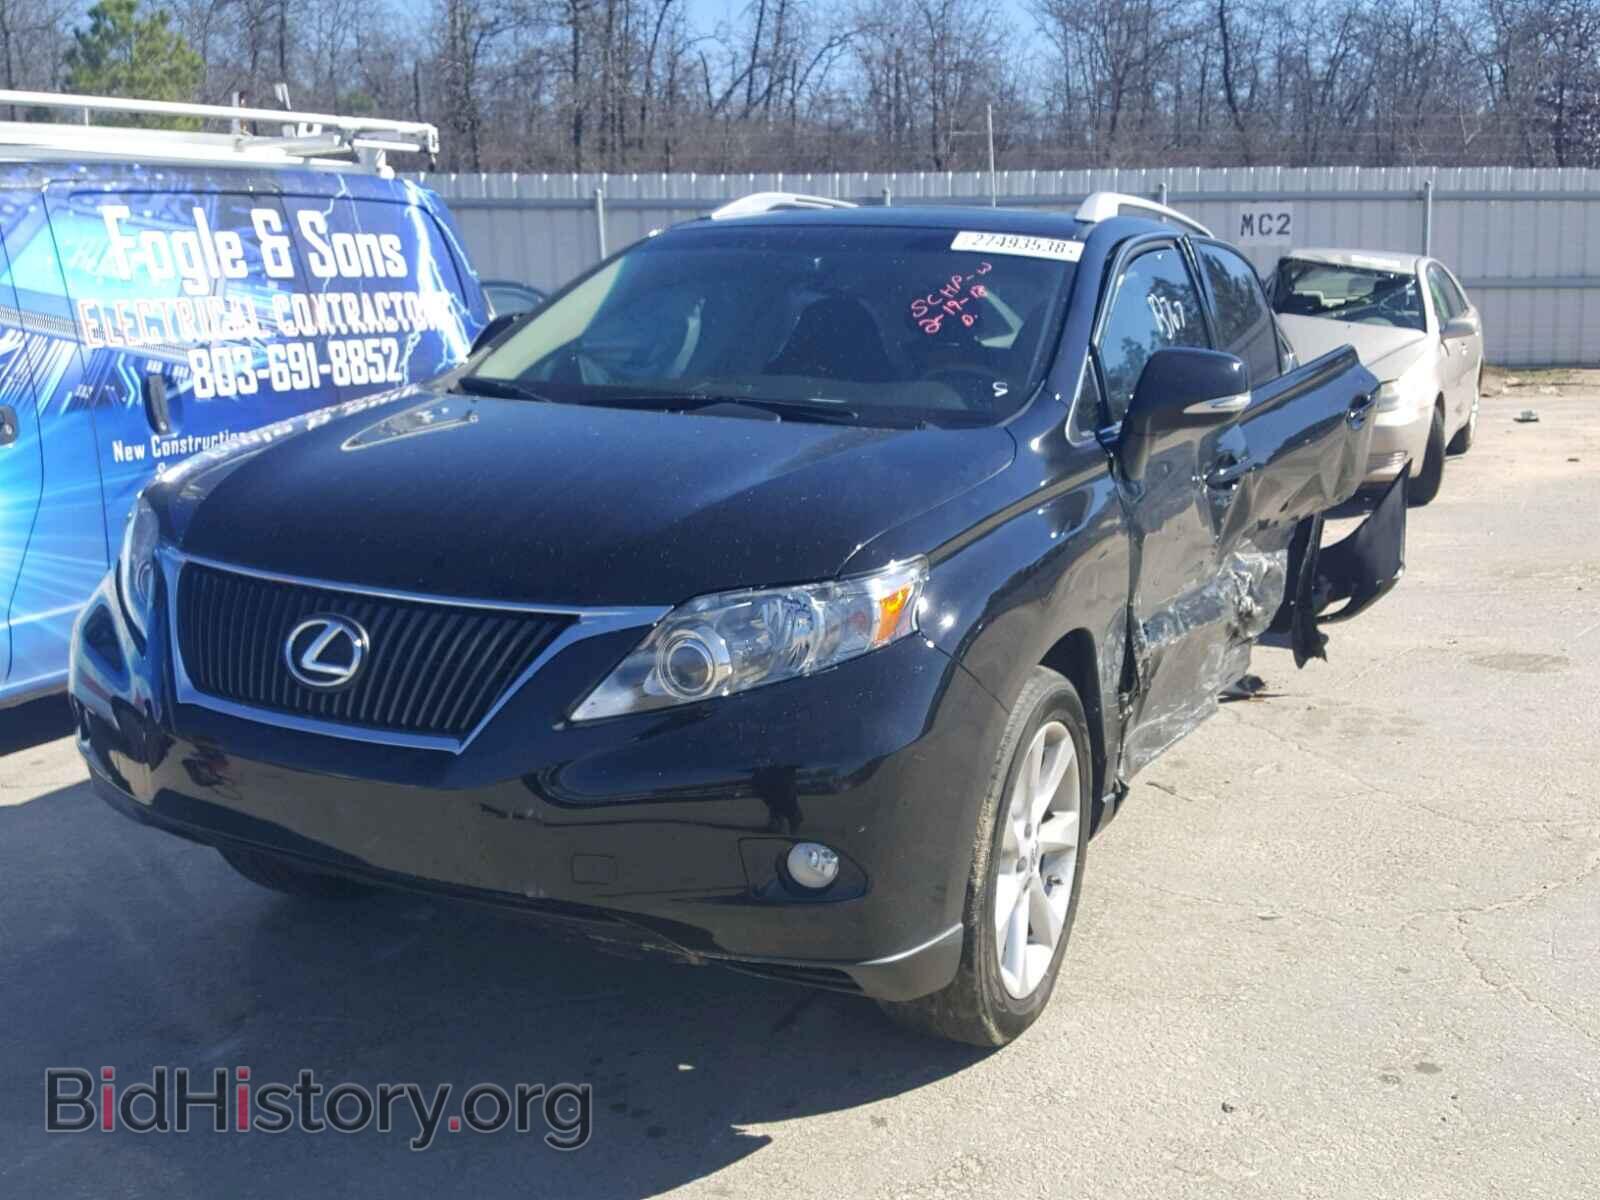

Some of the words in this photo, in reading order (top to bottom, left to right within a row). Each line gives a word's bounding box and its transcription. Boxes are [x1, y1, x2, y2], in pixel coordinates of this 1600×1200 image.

[99, 205, 249, 296] Fogle
[250, 208, 295, 280] &
[296, 209, 408, 280] Sons
[1240, 213, 1291, 237] MC2
[78, 297, 271, 349] ELECTRICAL
[272, 291, 453, 338] CONTRACTO
[187, 337, 405, 399] 803-691-8852
[111, 440, 146, 463] New
